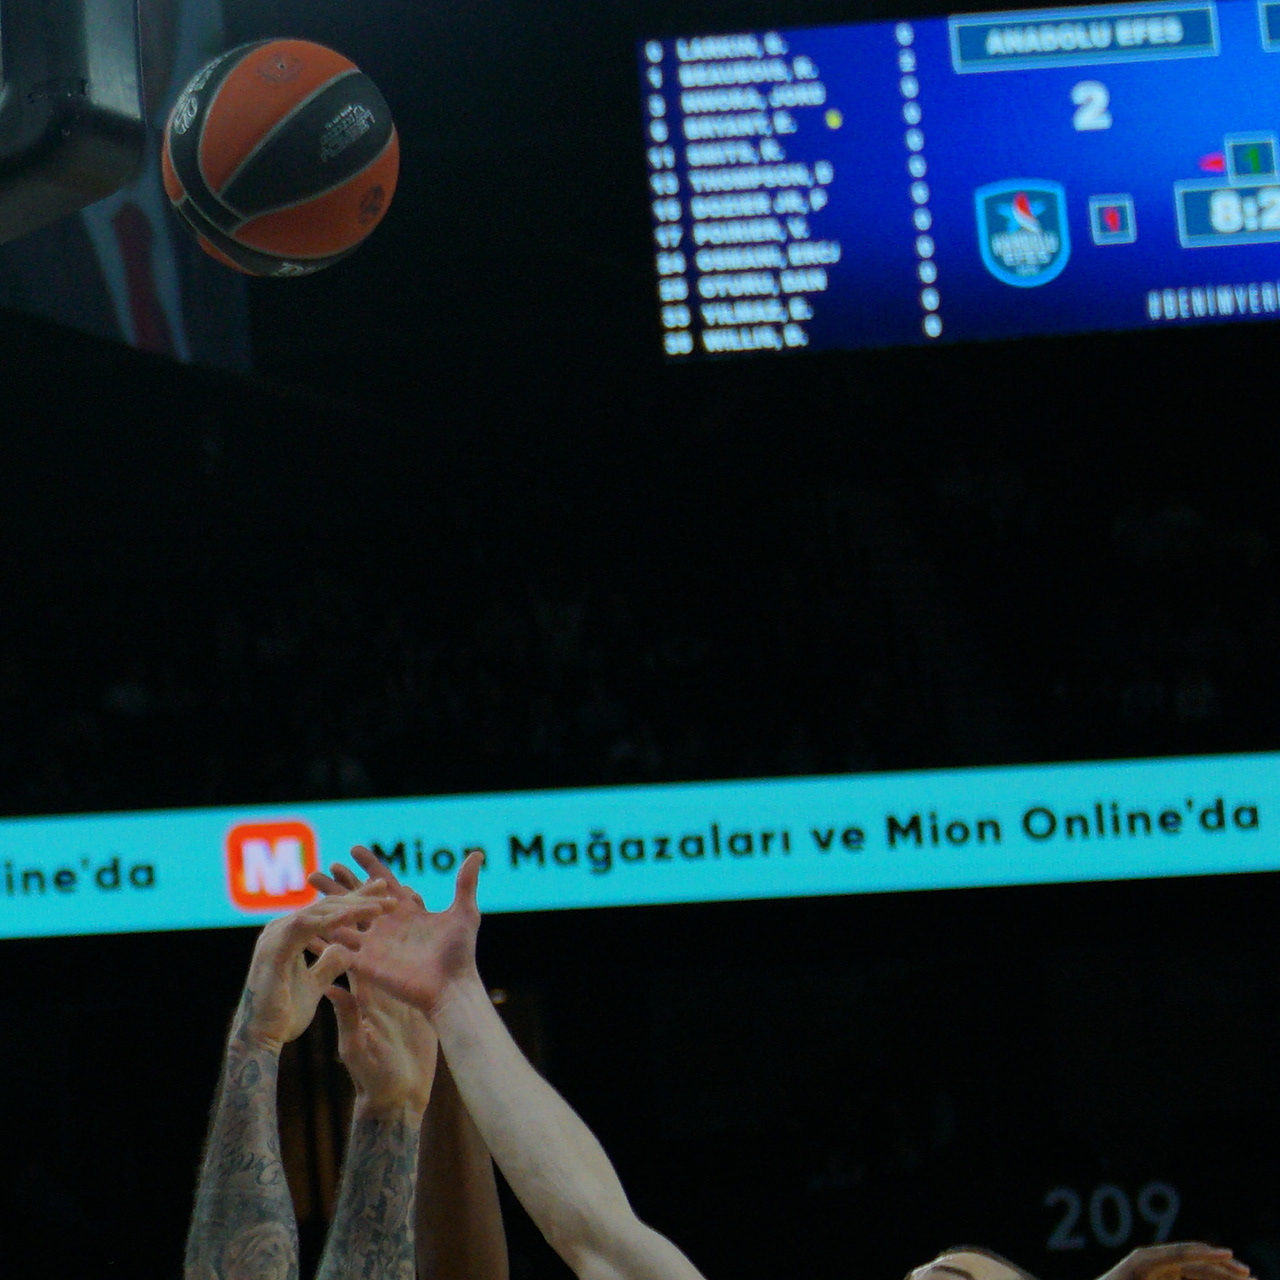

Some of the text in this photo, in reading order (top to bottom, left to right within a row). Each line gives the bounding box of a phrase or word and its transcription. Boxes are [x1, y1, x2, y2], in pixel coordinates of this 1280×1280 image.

[986, 20, 1113, 55] ANADOLU
[1071, 80, 1113, 131] 2
[509, 821, 791, 875] Mağazaları
[811, 824, 866, 853] ve
[885, 812, 1002, 848] Mion
[1021, 797, 1261, 842] Online'da
[1042, 1178, 1182, 1251] 209
